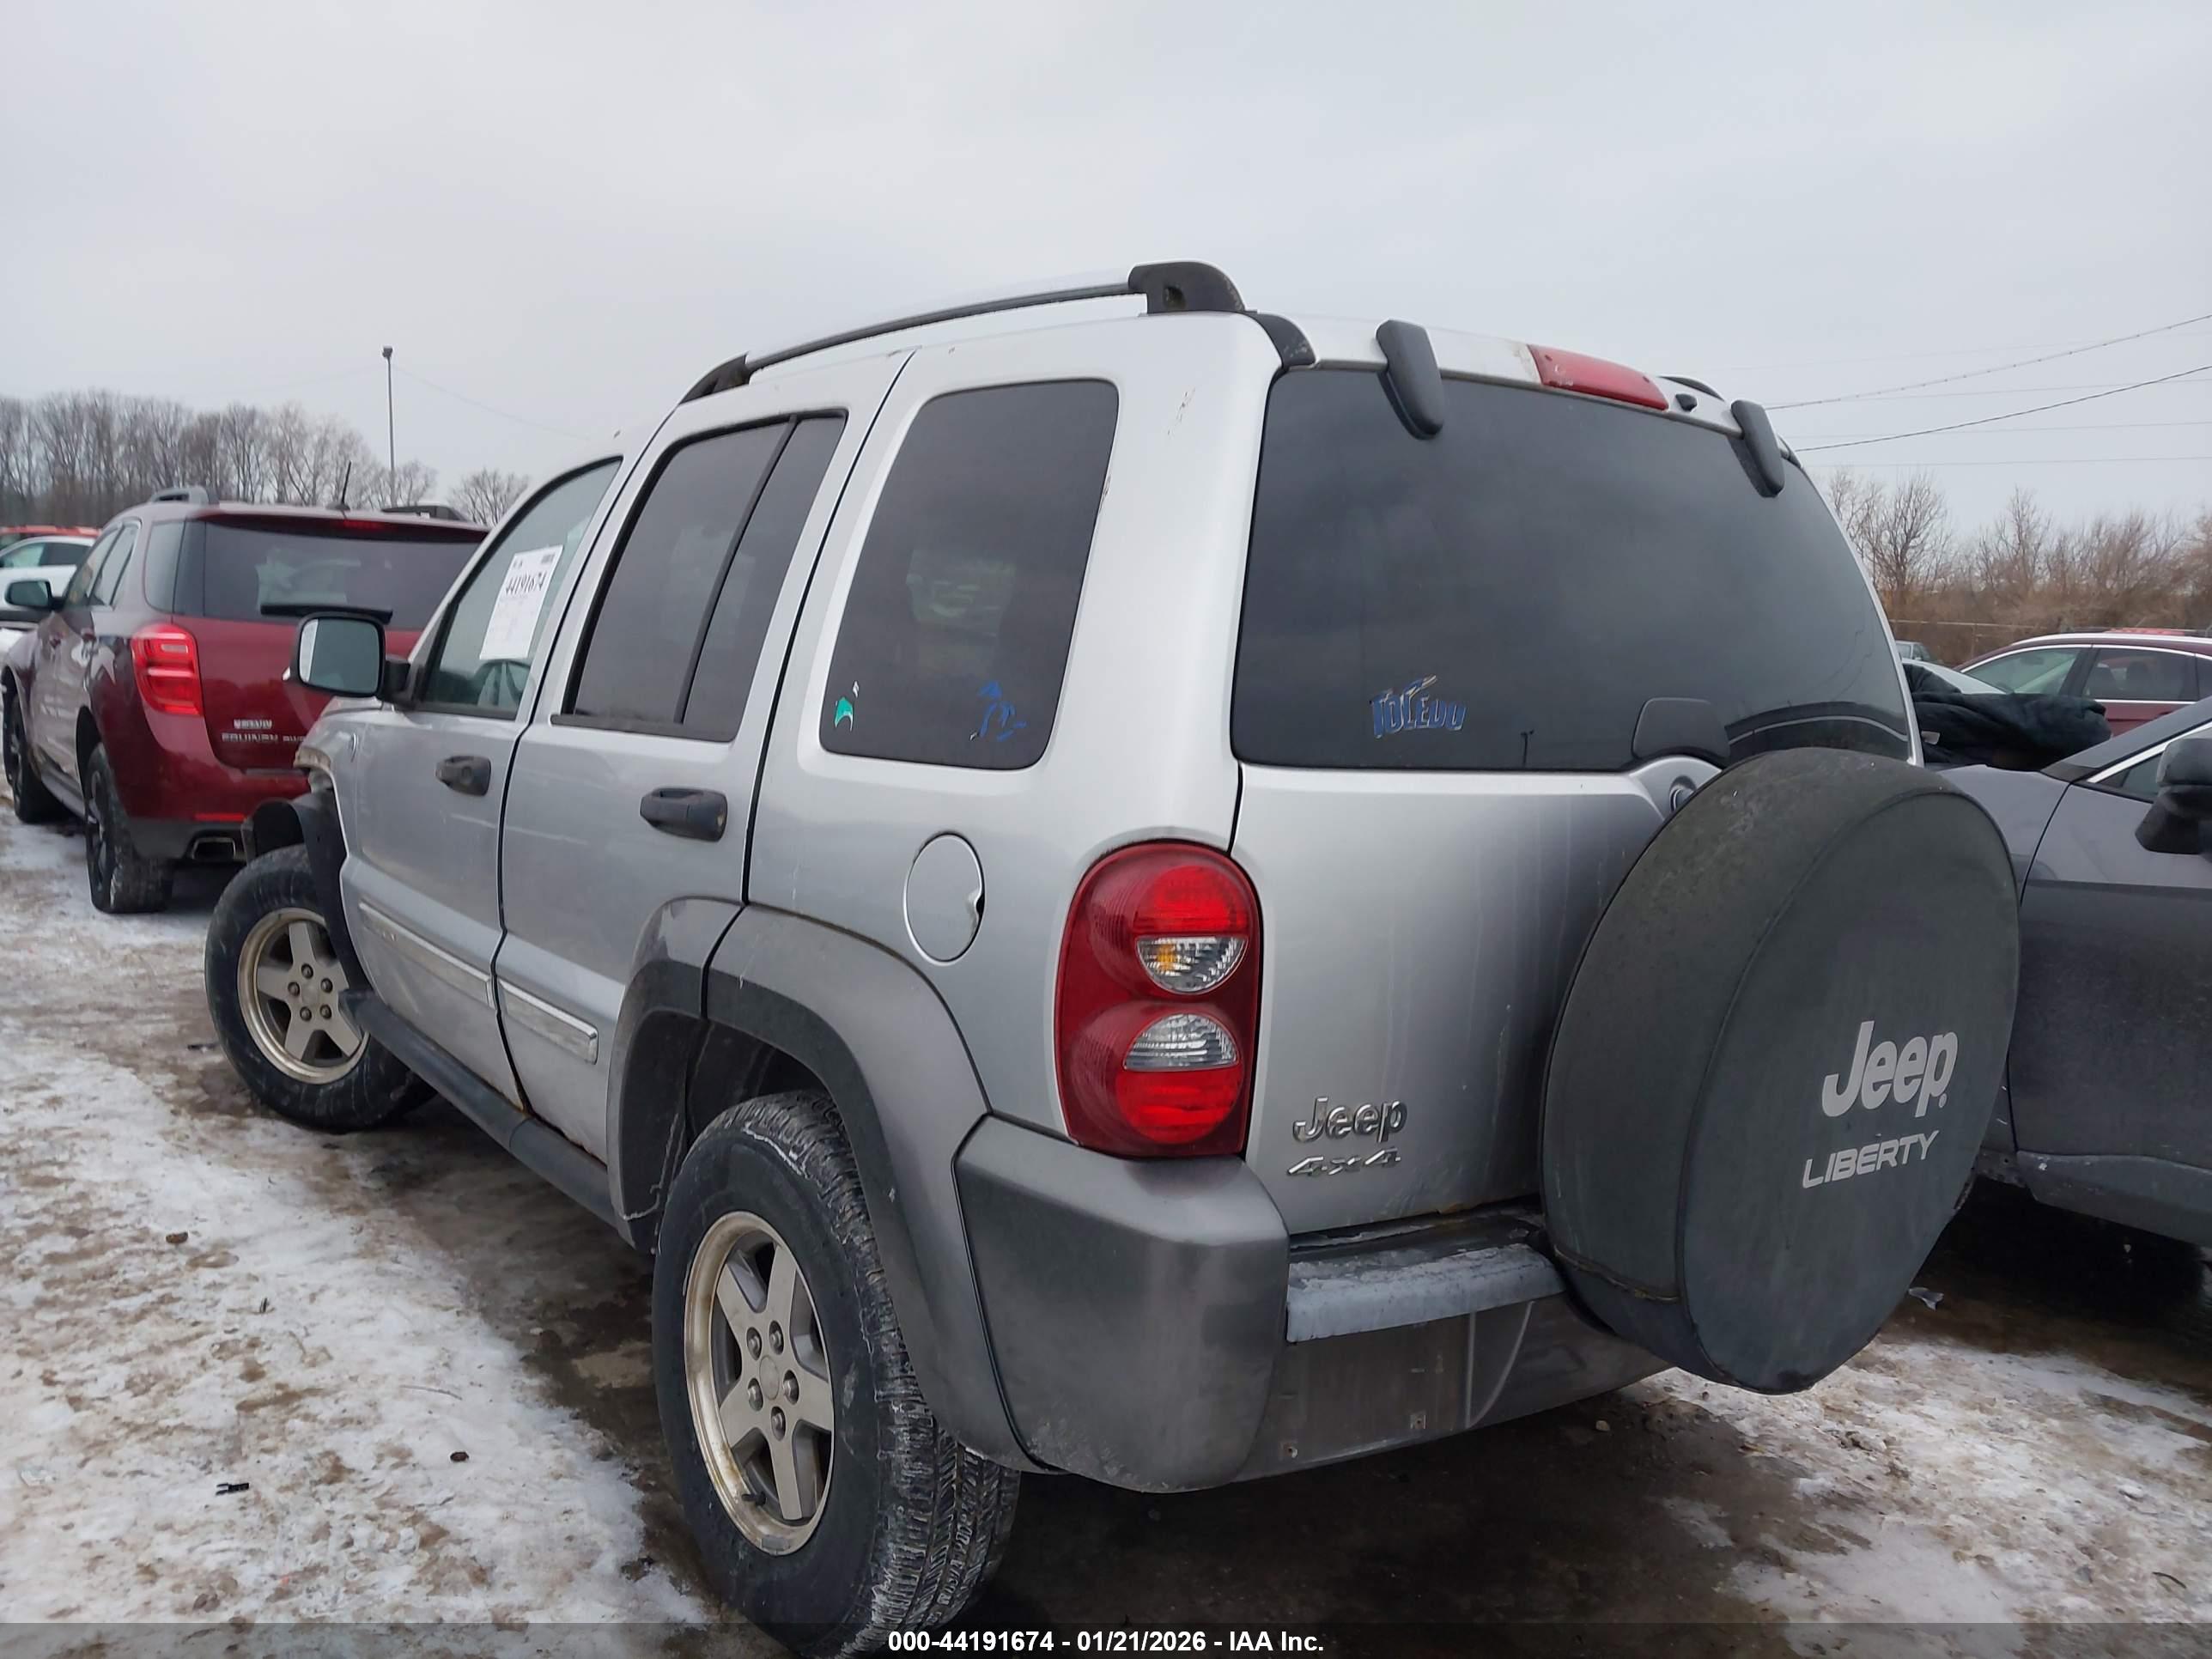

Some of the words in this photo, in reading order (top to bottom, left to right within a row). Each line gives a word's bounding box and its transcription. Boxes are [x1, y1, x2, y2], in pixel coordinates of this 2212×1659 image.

[1370, 675, 1467, 738] TOLEDO
[1821, 1019, 1959, 1118] Jeep
[1292, 1096, 1408, 1143] Jeep
[1802, 1129, 1941, 1189] LIBERTY
